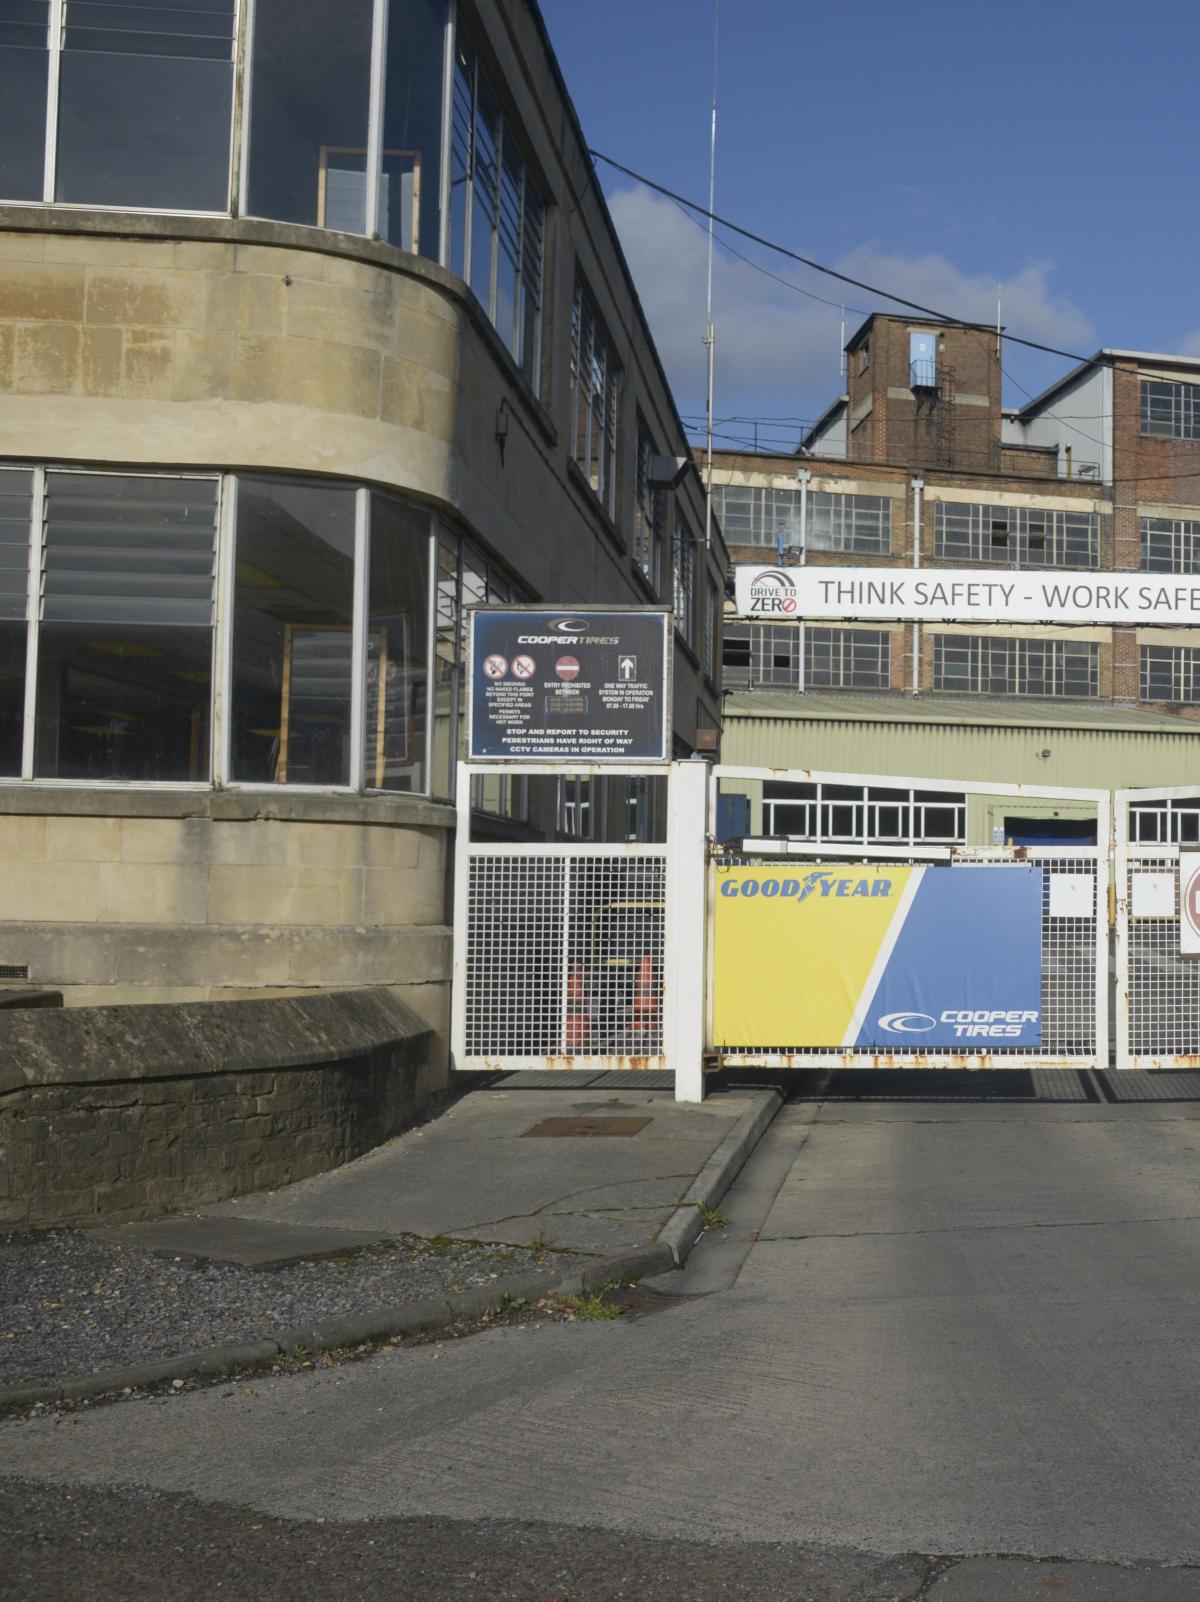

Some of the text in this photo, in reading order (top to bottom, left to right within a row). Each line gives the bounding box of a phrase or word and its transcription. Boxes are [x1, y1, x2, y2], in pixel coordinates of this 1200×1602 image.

[750, 588, 796, 597] DRIVE TO
[818, 581, 905, 605] THINK
[914, 582, 1015, 607] SAFETY
[1042, 585, 1129, 610] WORK
[751, 597, 796, 612] ZERO
[940, 1010, 1038, 1023] COOPER
[953, 1024, 1023, 1037] TIRES
